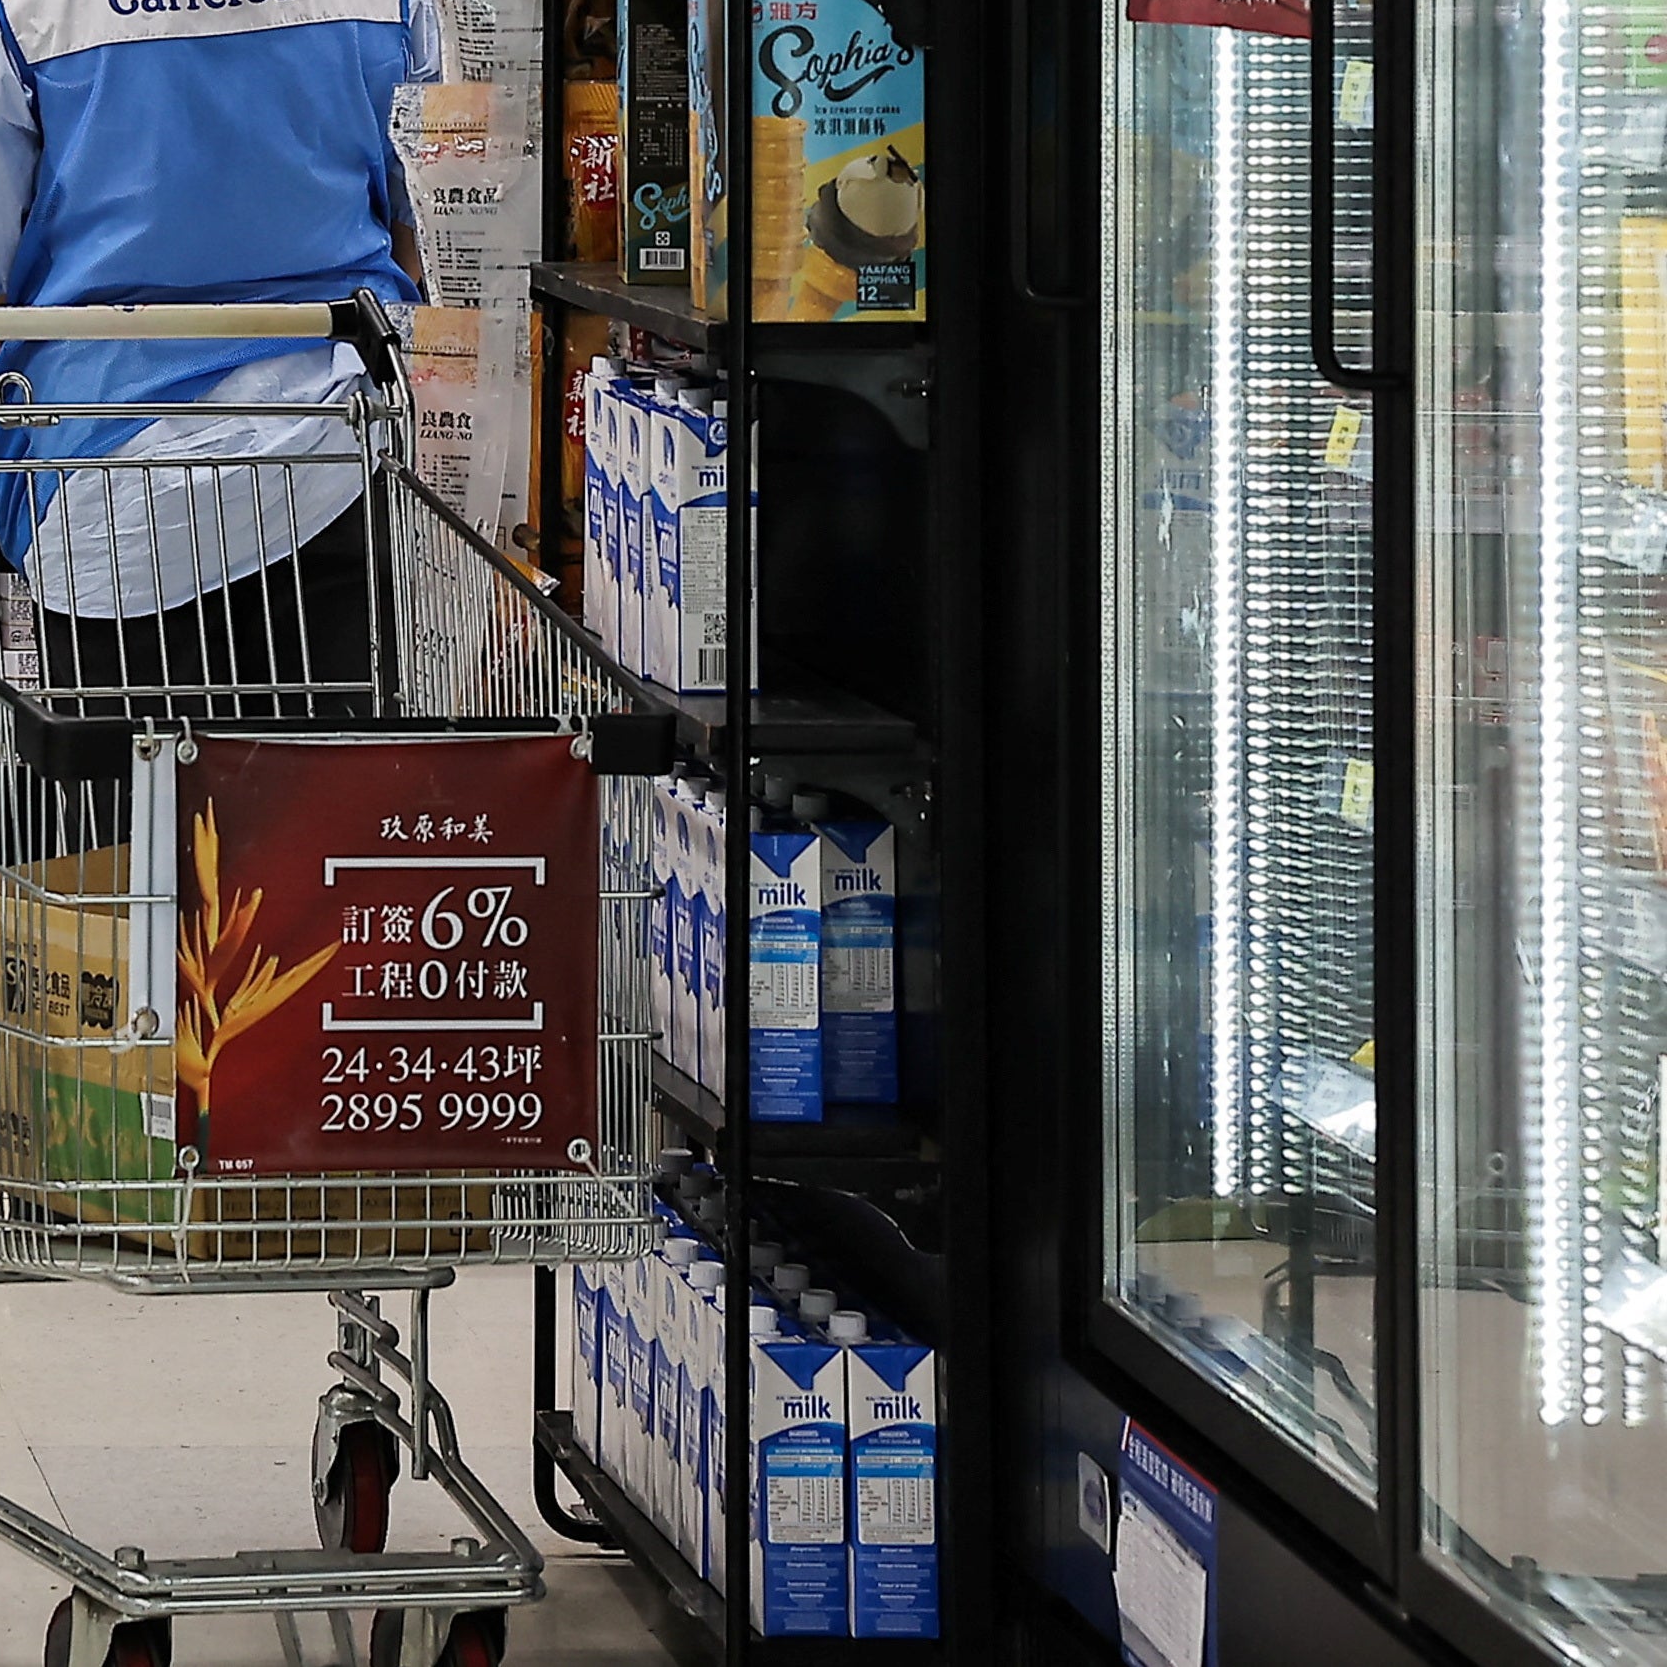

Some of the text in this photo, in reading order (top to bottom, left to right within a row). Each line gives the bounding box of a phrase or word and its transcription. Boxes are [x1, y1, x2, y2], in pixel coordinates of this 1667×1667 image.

[769, 1, 818, 20] 雅方
[856, 286, 878, 303] 12
[699, 467, 726, 488] mi
[379, 813, 494, 844] 玖原和美
[757, 879, 807, 907] milk
[832, 868, 883, 894] milk
[340, 885, 529, 951] 訂簽6%
[340, 957, 528, 1001] 工程0付款
[47, 1001, 71, 1017] BEST
[320, 1091, 543, 1133] 2895 9999
[783, 1395, 832, 1420] milk
[872, 1395, 923, 1420] milk
